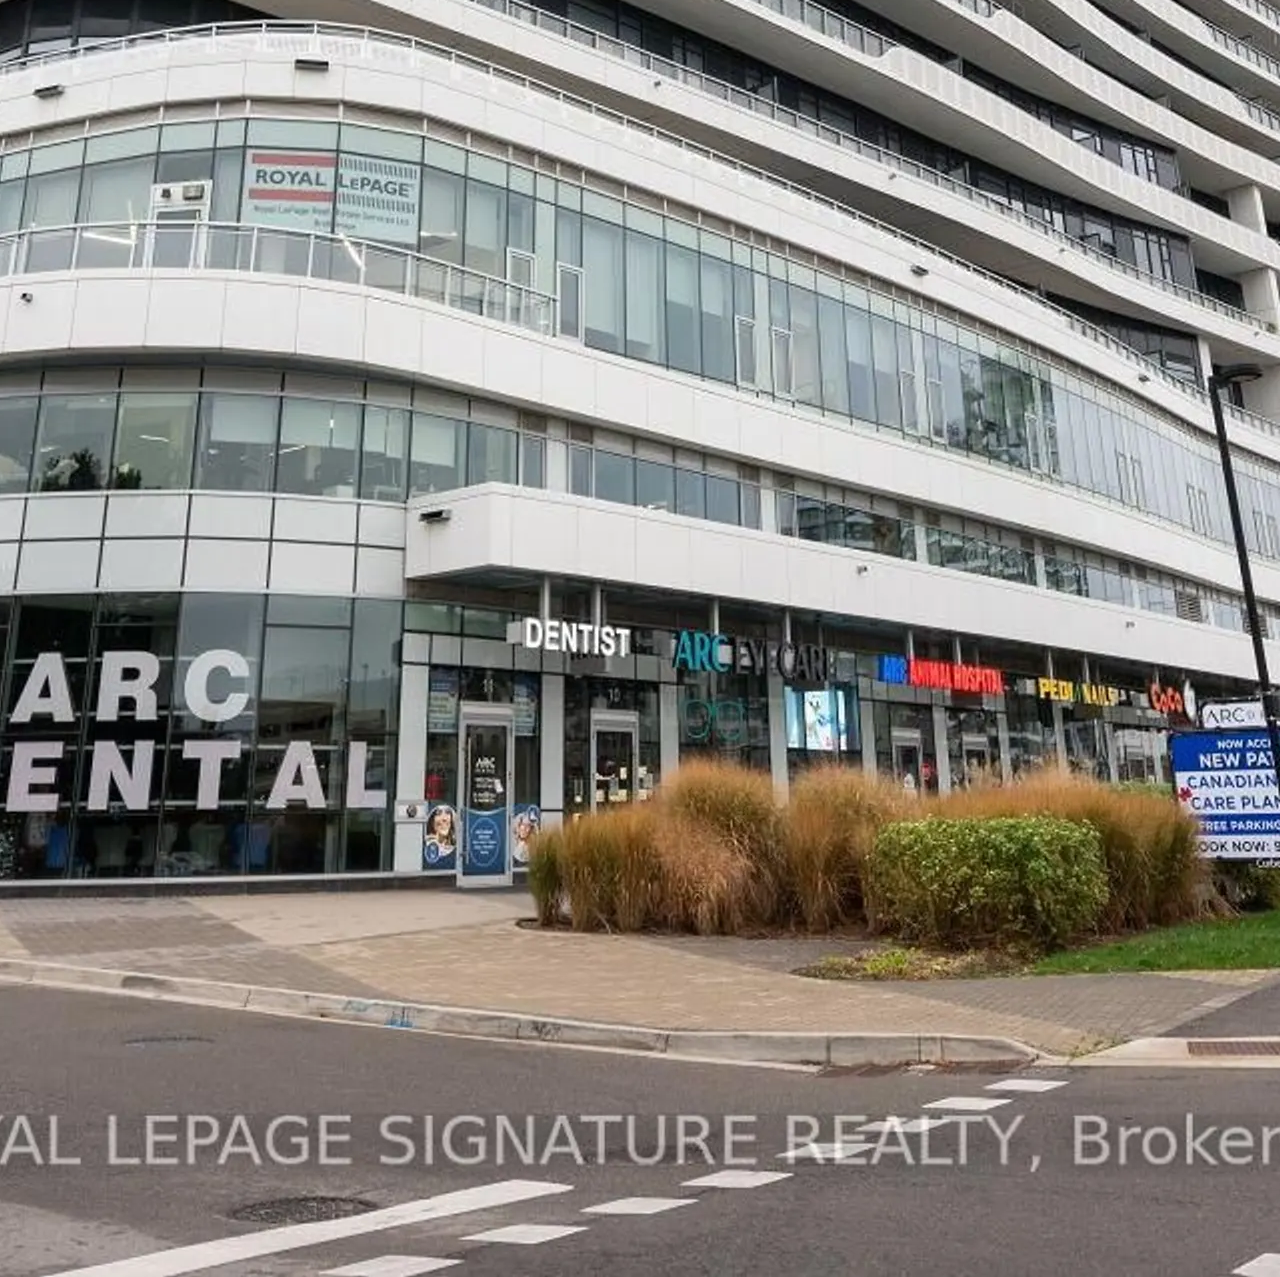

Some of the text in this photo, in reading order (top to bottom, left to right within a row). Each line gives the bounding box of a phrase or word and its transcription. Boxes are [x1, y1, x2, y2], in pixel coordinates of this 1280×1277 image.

[255, 168, 327, 187] ROYAL
[525, 617, 631, 658] DENTIST
[673, 627, 730, 673] ARC
[910, 658, 951, 690] ANIMAL
[953, 664, 1003, 695] HOSPITAL
[9, 649, 250, 723] ARC
[1038, 676, 1073, 702] PEDI
[1206, 708, 1245, 723] ARC
[1217, 739, 1243, 749] NOW
[1199, 753, 1240, 769] NEW
[1187, 774, 1278, 789] CANADIAN
[1192, 796, 1236, 810] CARE
[1199, 820, 1227, 832] FREE
[1198, 840, 1229, 852] OOK
[1232, 840, 1269, 852] NOW:
